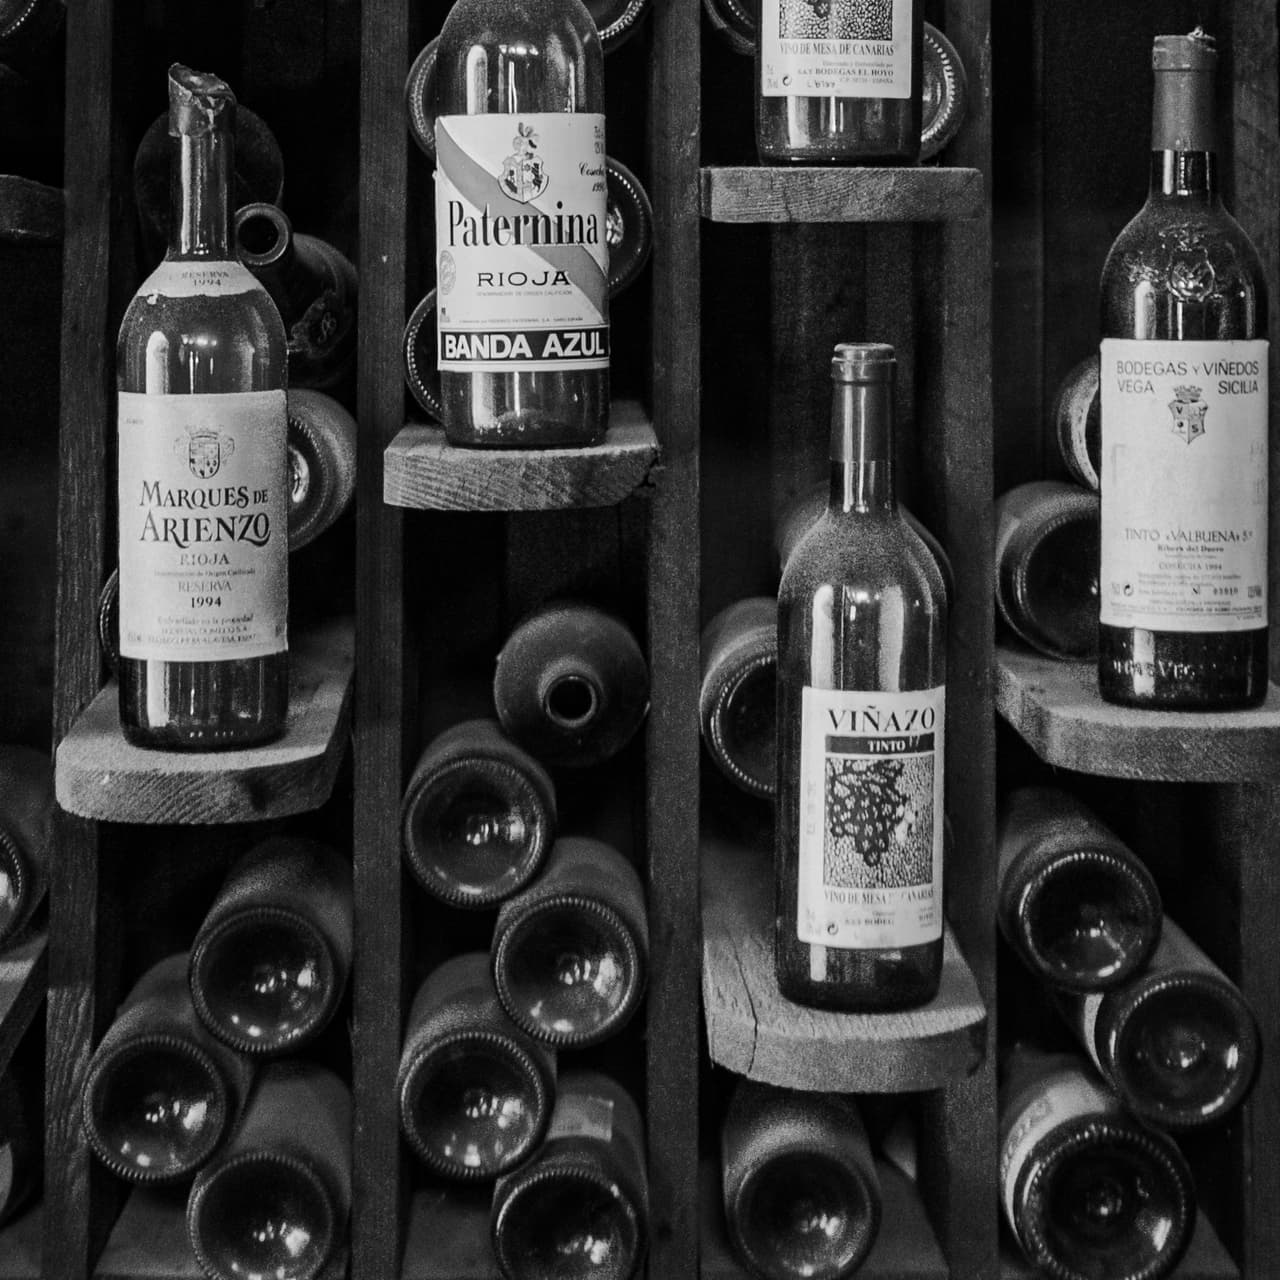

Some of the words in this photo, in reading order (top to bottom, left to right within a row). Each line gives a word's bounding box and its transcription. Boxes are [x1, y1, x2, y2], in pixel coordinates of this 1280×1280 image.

[800, 42, 811, 56] DE
[812, 42, 838, 56] MESA
[839, 42, 852, 56] DE
[852, 42, 895, 57] CANARIAS
[447, 199, 599, 248] Paternina
[191, 278, 220, 287] 1994
[477, 271, 572, 287] RIOJA
[444, 333, 533, 360] BANDA
[541, 331, 605, 358] AZUL
[1116, 360, 1188, 376] BODEGAS
[1202, 358, 1260, 376] VIÑEDOS
[1117, 380, 1156, 395] VEGA
[1218, 379, 1260, 396] SICILIA
[138, 480, 249, 509] MARQUES
[253, 488, 269, 504] DE
[138, 510, 272, 549] ARIENZO
[1125, 527, 1161, 542] TINTO
[179, 554, 230, 566] RIOJA
[177, 581, 233, 593] RESERVA
[190, 596, 223, 609] 1994
[826, 704, 936, 734] VIÑAZO
[867, 739, 906, 752] TINTO
